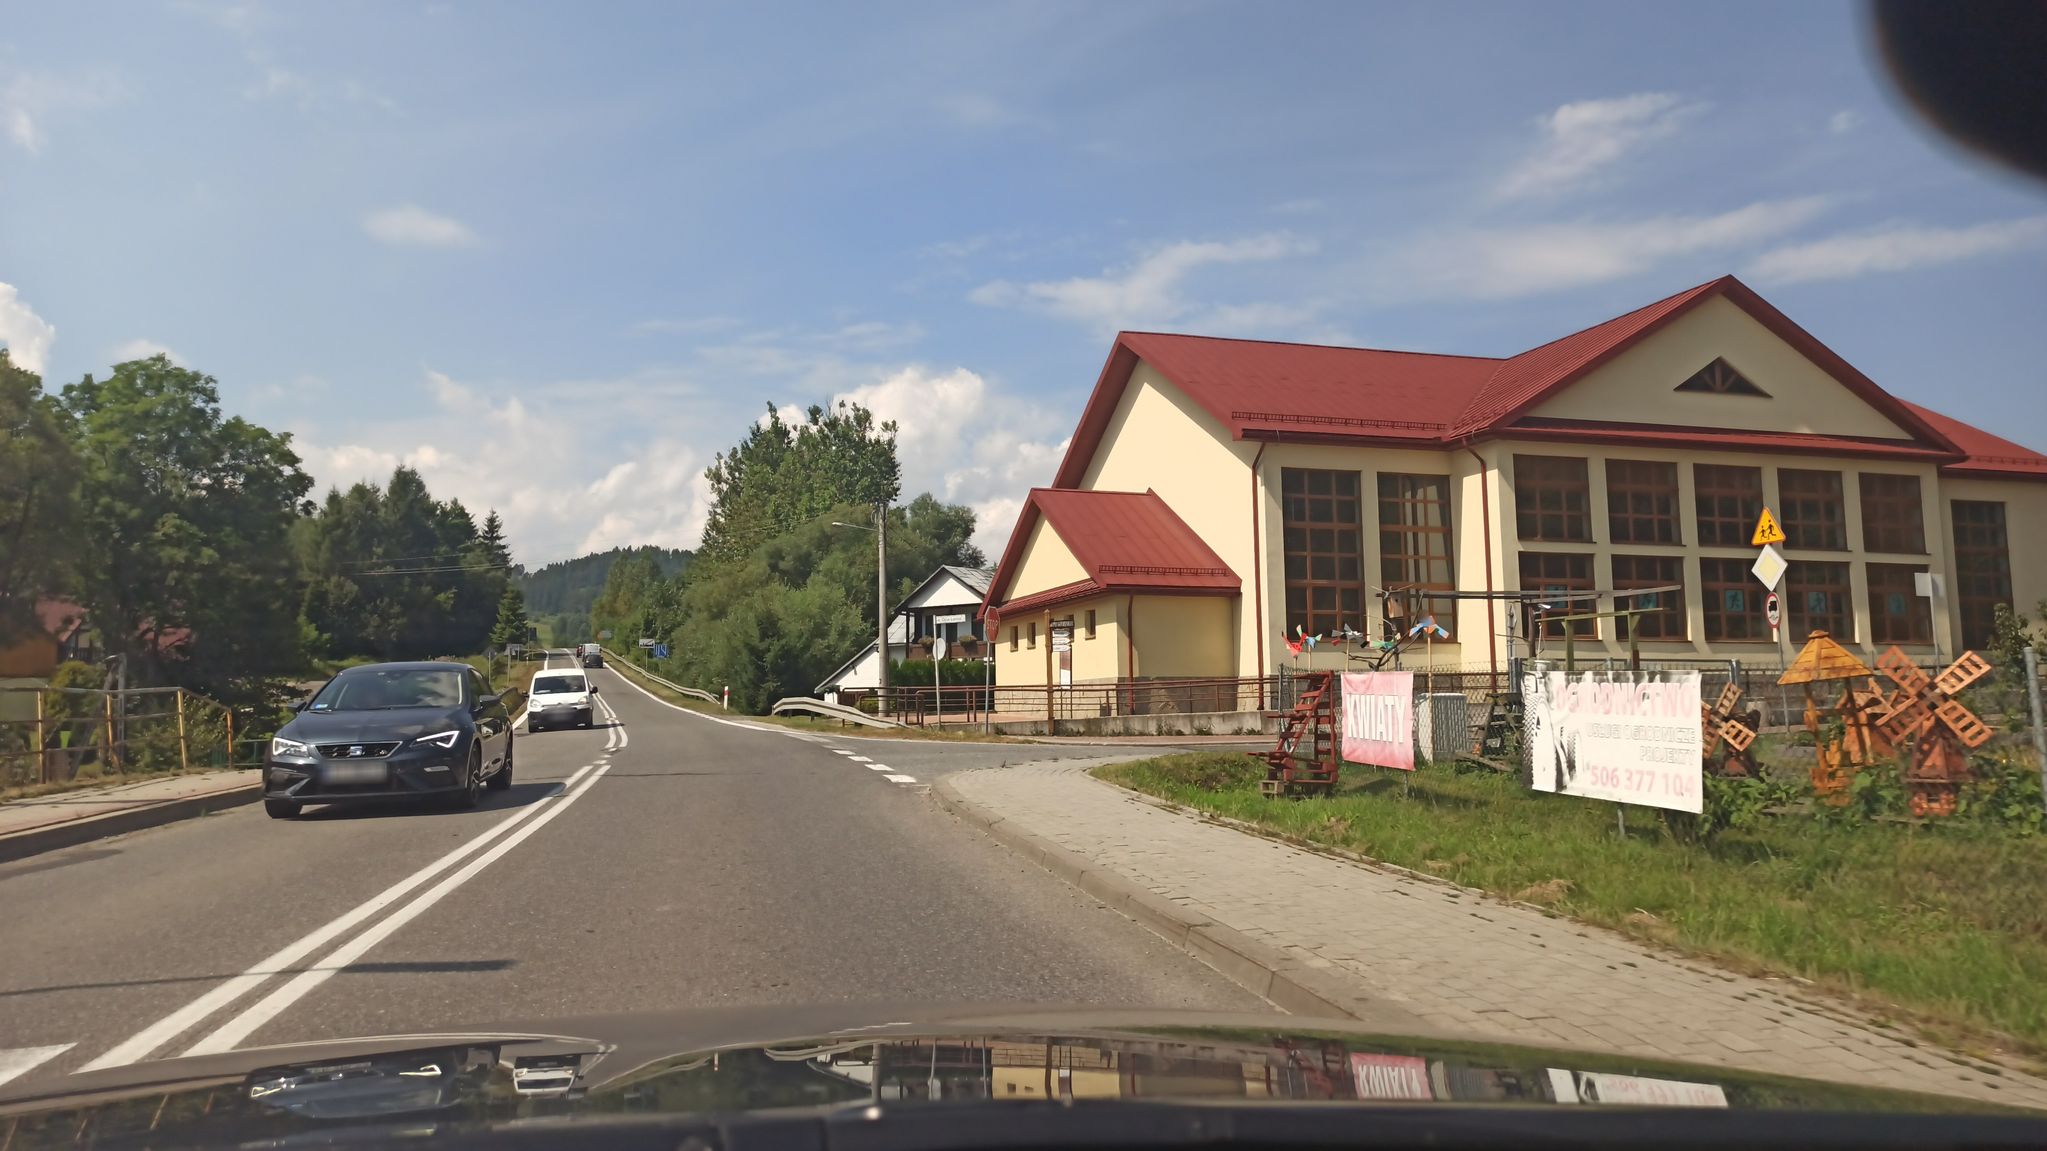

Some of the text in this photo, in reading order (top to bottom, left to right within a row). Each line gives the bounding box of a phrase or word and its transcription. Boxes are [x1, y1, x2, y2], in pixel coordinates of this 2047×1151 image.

[986, 619, 999, 630] STOP
[1347, 695, 1406, 743] KWIATY
[1590, 765, 1695, 797] 506 377 104
